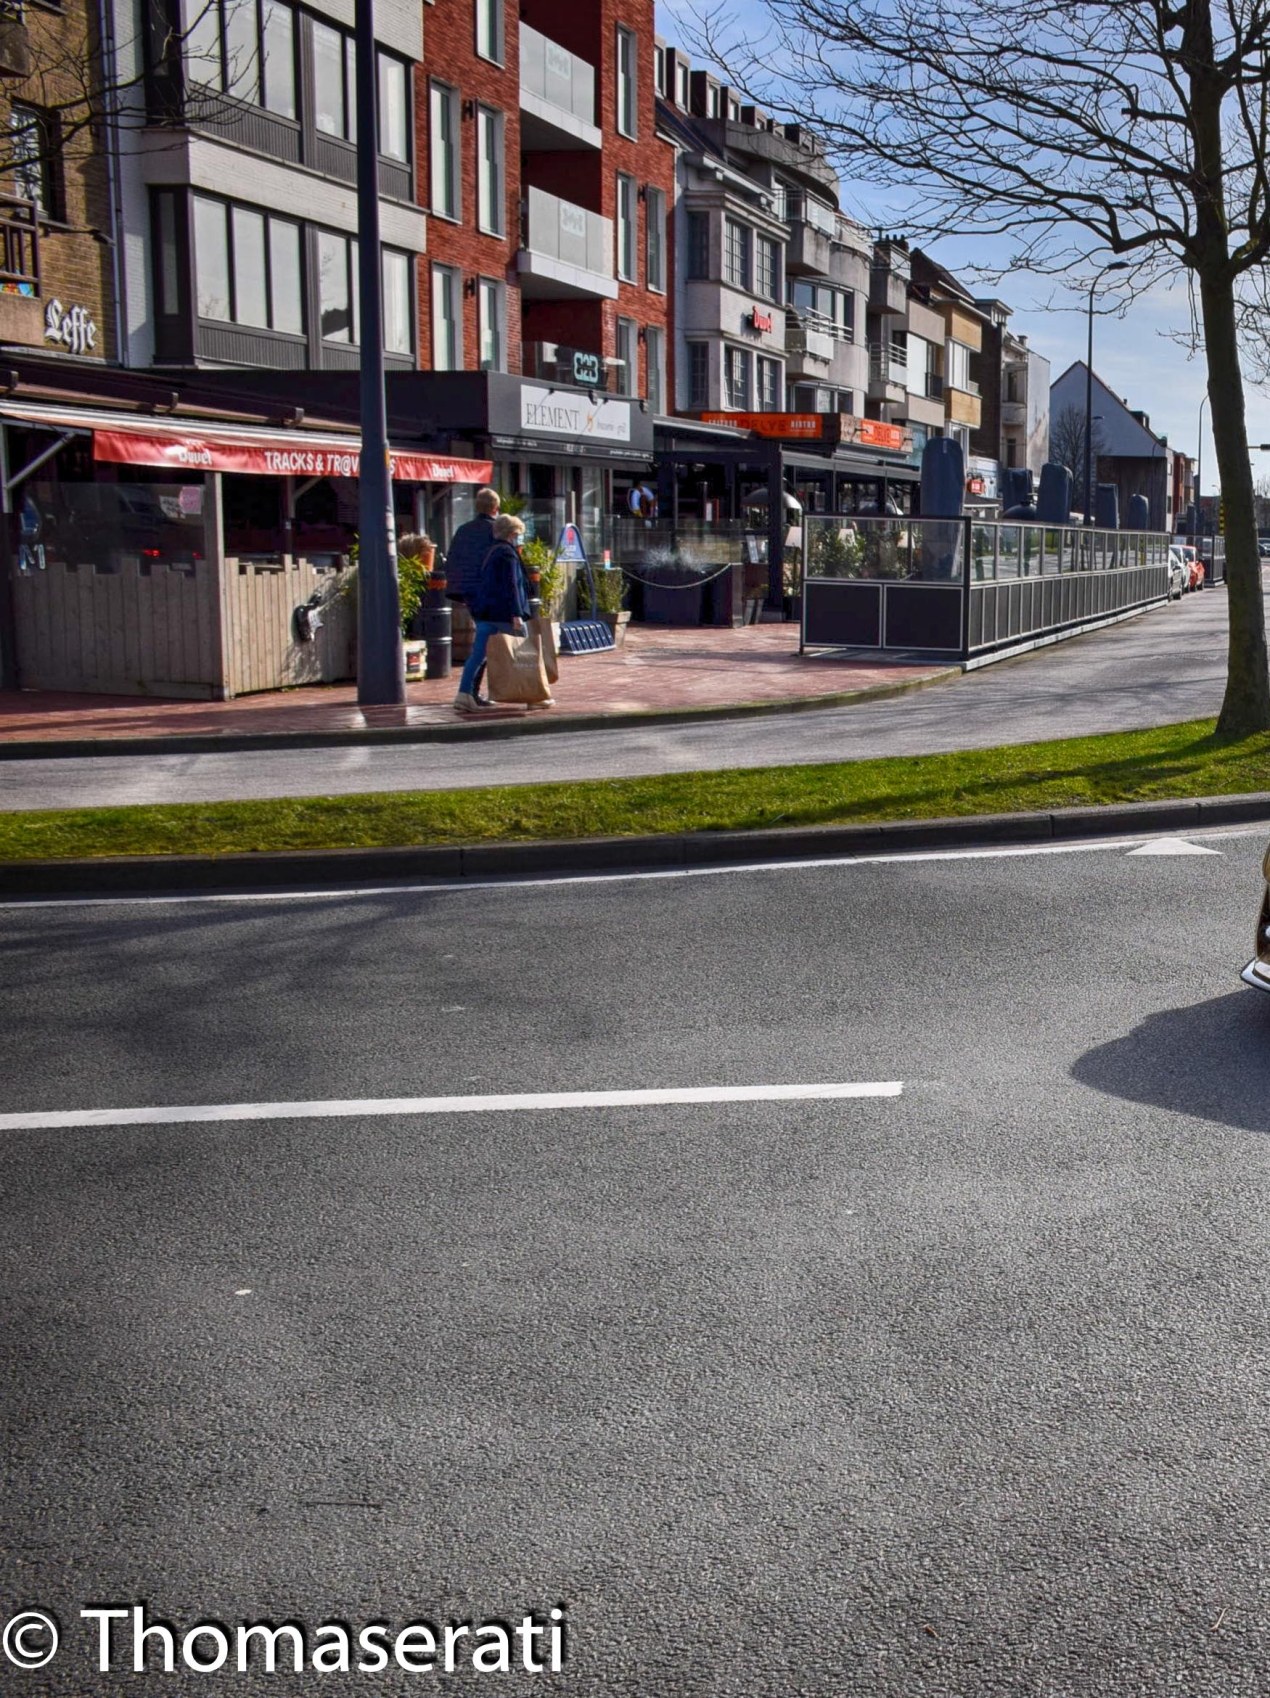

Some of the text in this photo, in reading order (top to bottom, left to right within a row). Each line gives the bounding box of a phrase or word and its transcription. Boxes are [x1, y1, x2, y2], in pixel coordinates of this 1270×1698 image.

[45, 298, 97, 354] Leffe
[526, 403, 579, 431] ELEMENT
[264, 451, 396, 476] TRACKS & TR@VS
